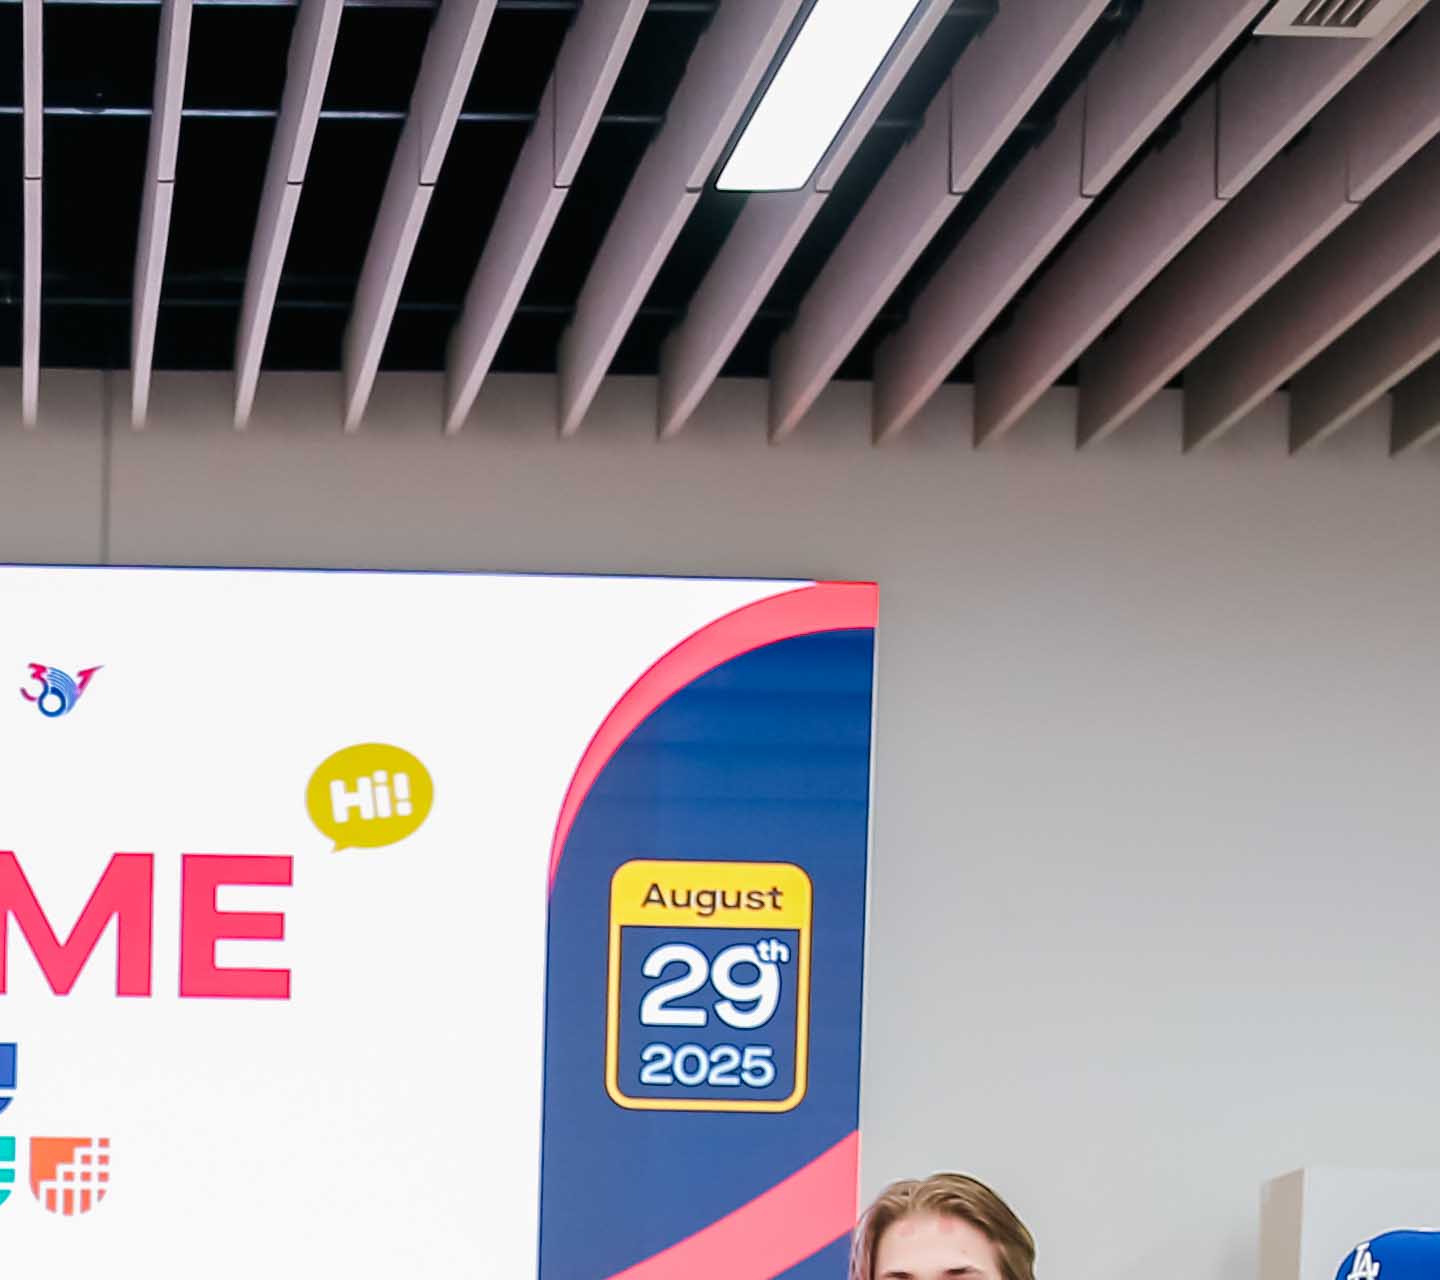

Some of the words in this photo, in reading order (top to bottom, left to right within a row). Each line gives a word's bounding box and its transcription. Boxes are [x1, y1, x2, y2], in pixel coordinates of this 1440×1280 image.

[330, 769, 413, 824] Hi!
[641, 882, 784, 917] August
[639, 1042, 777, 1089] 2025
